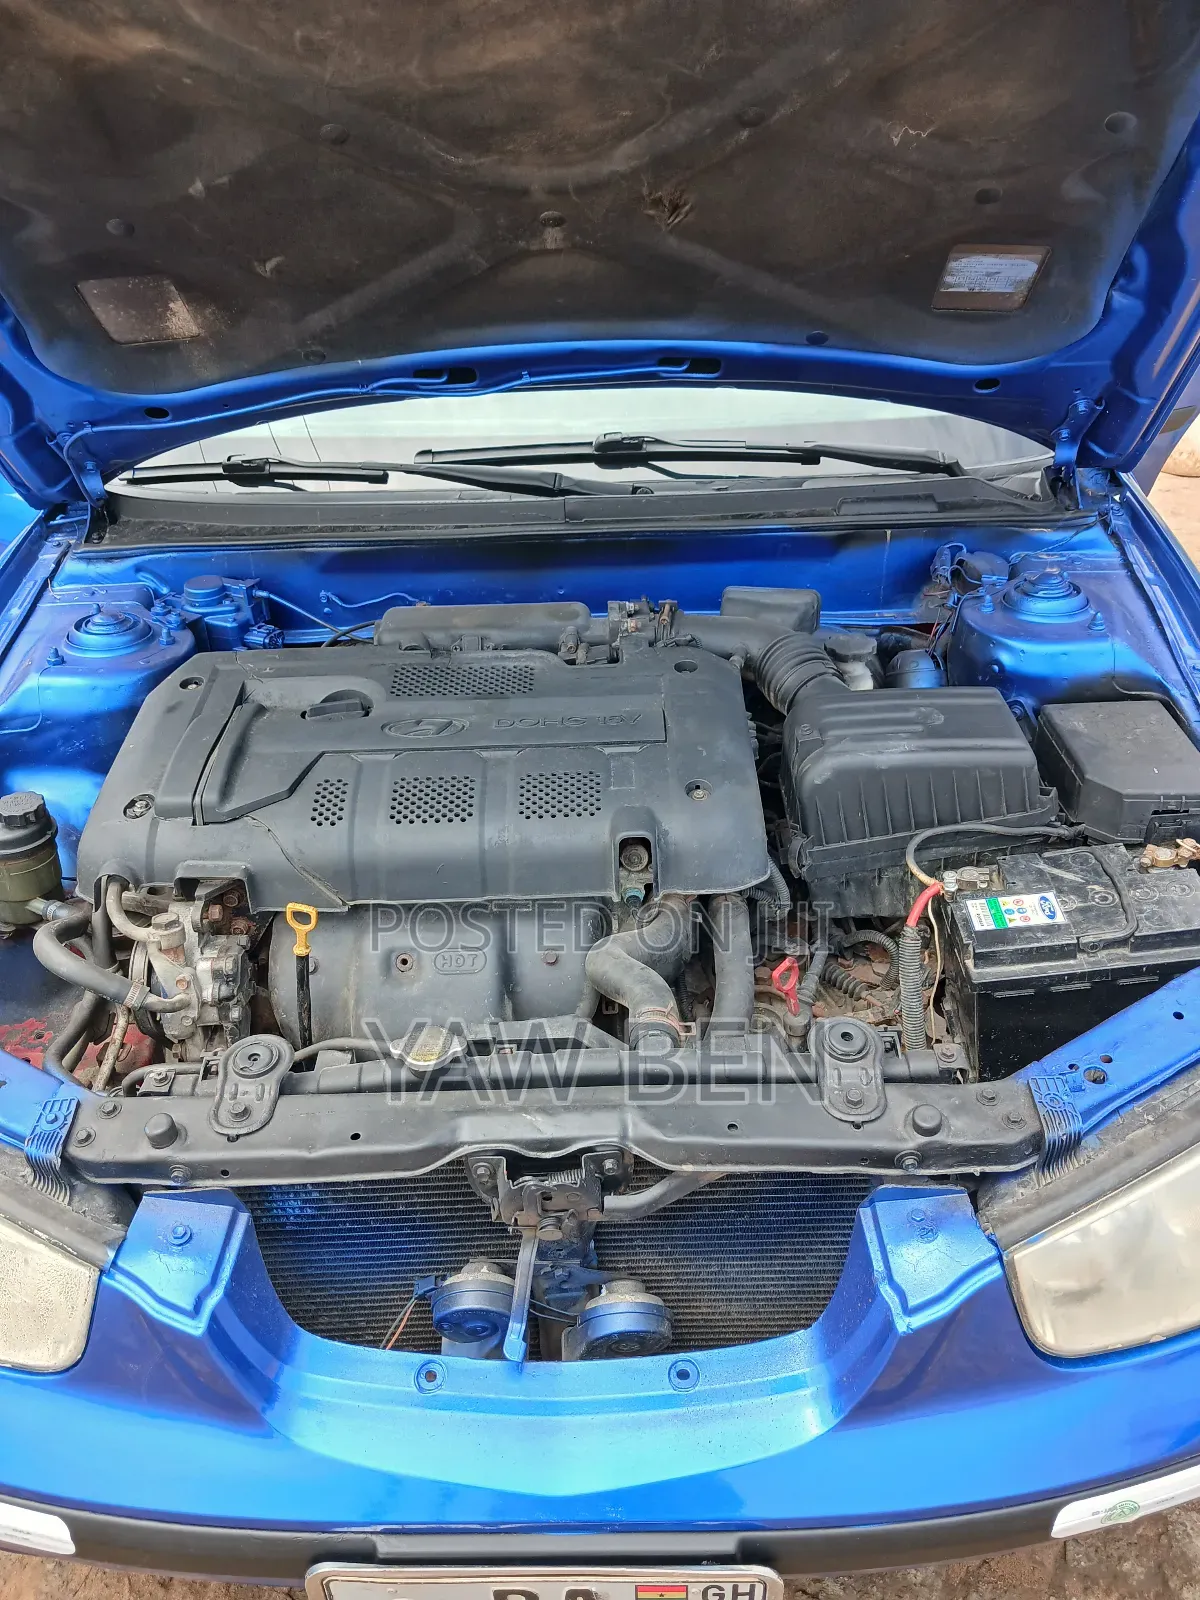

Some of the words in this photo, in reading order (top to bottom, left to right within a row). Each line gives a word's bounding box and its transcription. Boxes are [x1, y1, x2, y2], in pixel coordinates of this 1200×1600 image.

[493, 715, 588, 729] DOHC
[597, 713, 643, 726] 16V
[440, 952, 479, 969] HOT
[701, 1583, 756, 1600] GH
